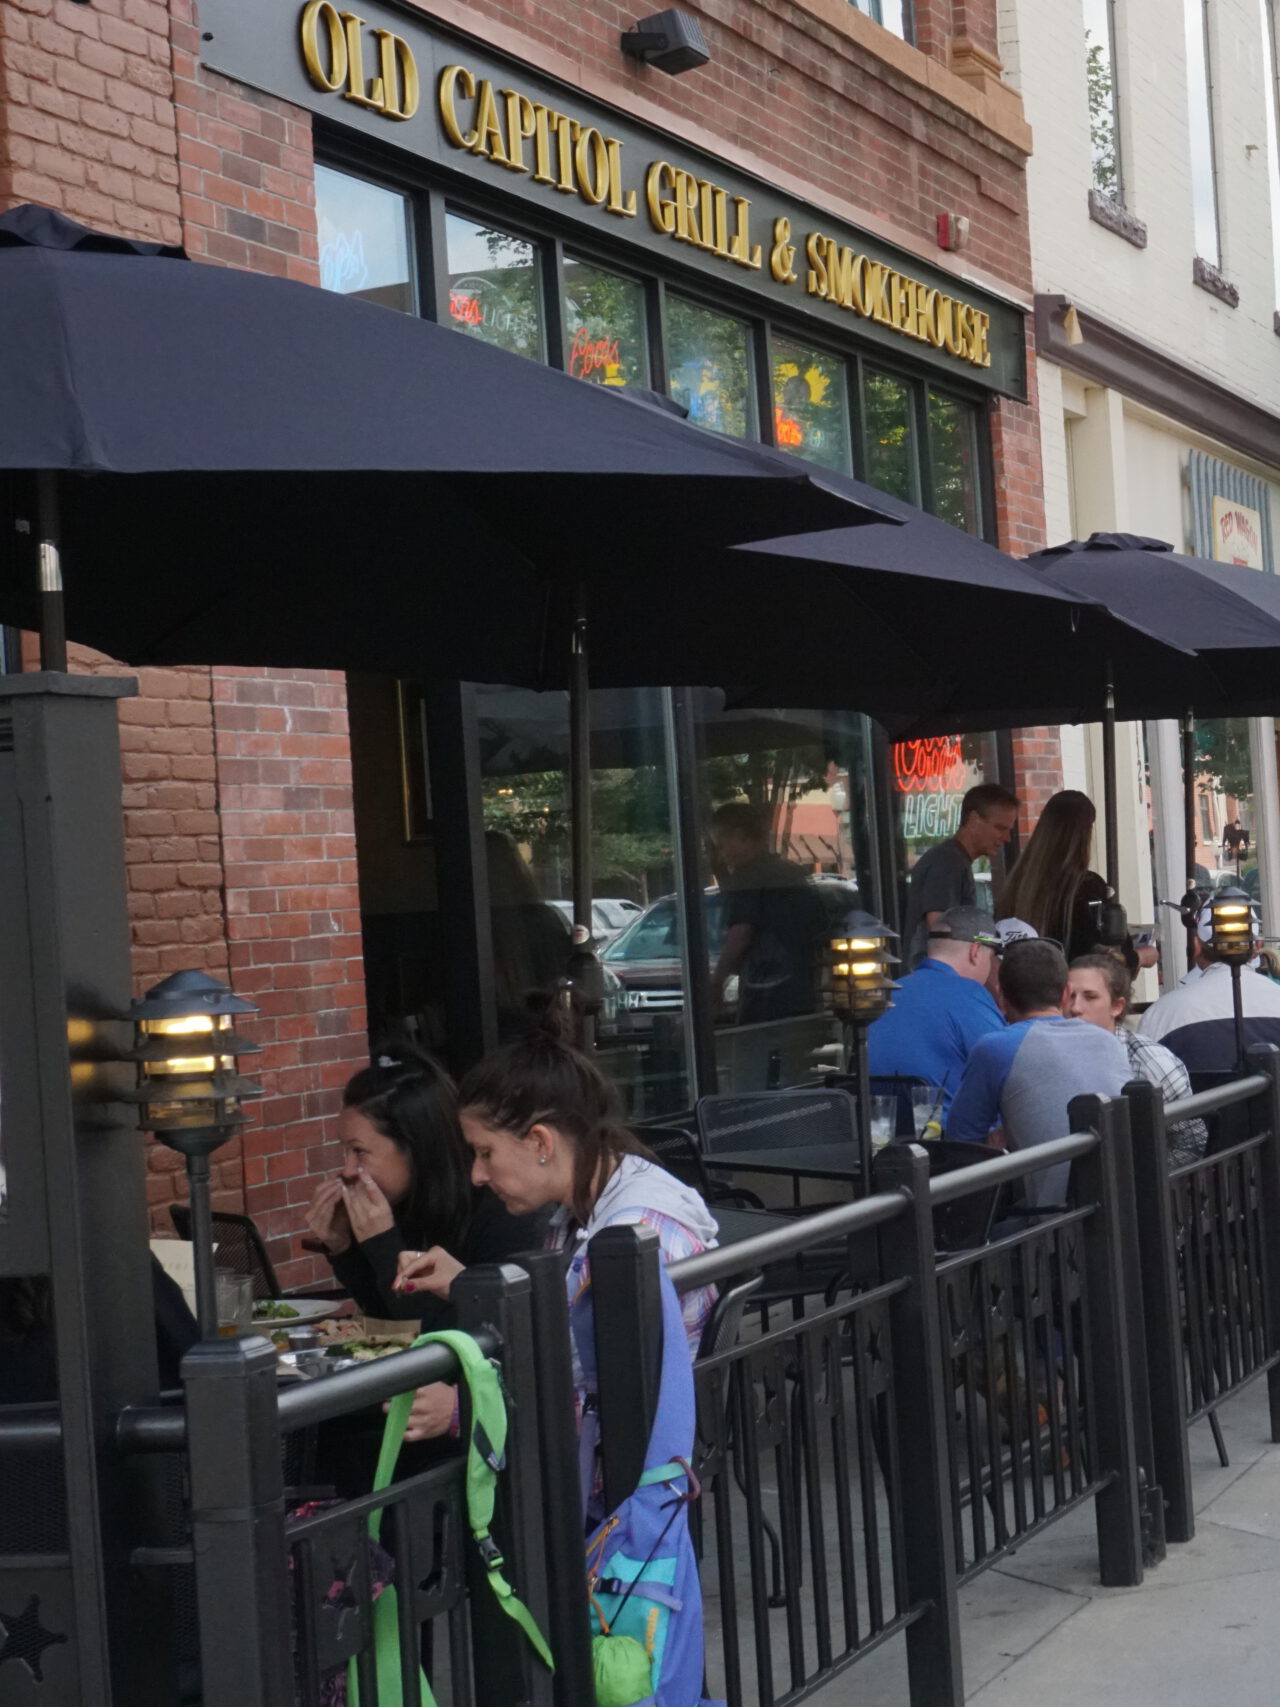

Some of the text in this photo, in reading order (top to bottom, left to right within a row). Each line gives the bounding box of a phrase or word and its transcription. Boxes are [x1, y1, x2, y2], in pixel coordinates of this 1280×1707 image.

[302, 0, 991, 368] OLD CAPITOL GRILL & SMOKEHOUSE
[904, 794, 965, 838] LIGHT
